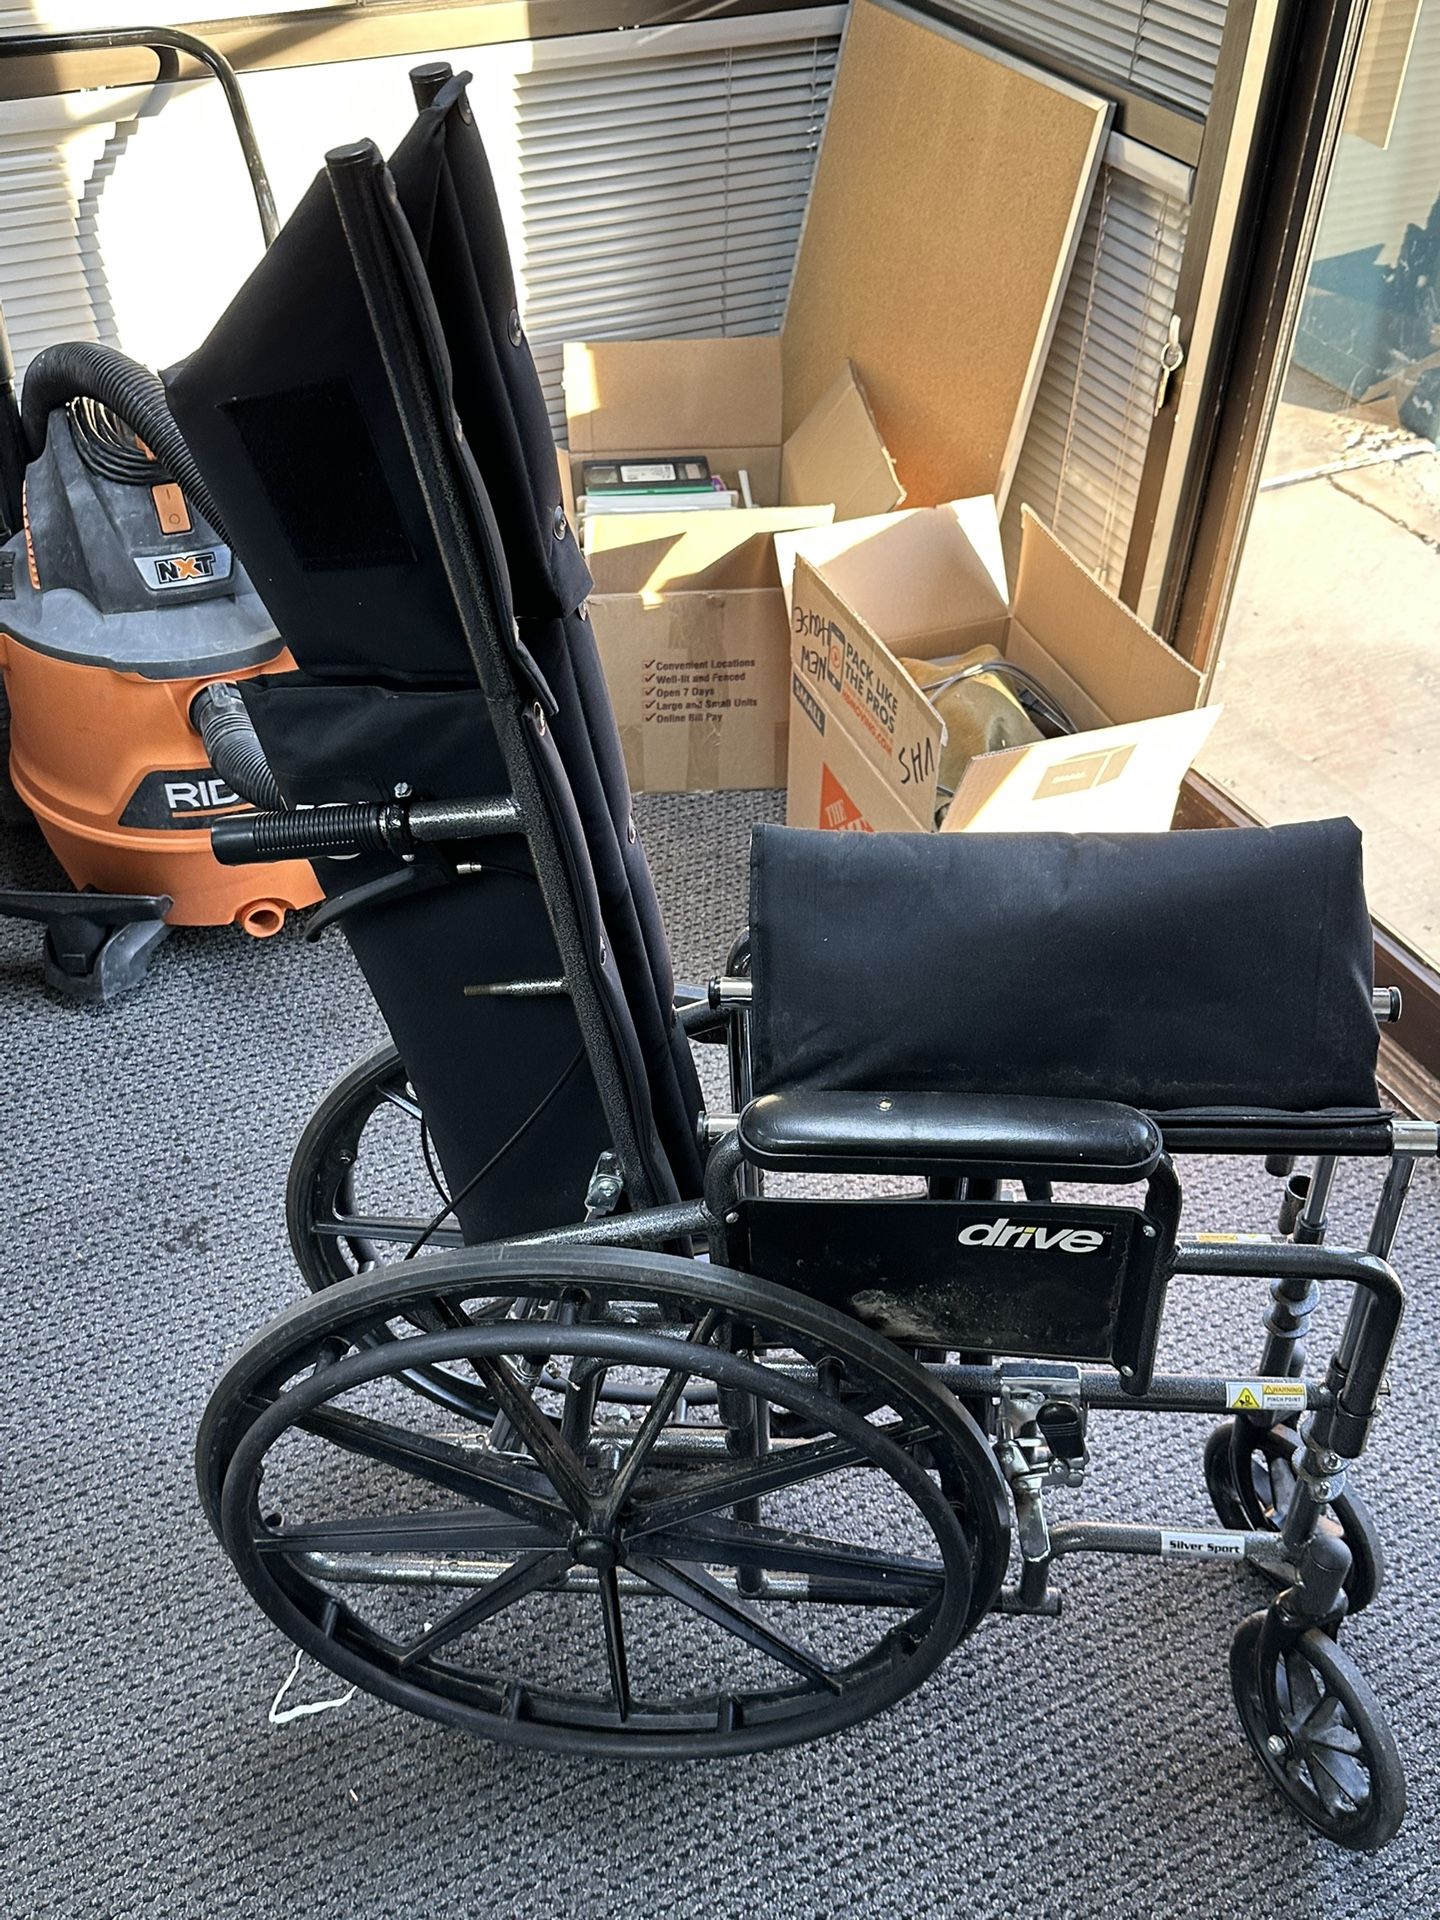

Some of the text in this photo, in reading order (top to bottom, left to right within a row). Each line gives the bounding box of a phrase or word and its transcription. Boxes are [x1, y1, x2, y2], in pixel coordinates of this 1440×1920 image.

[155, 553, 215, 584] NXT
[656, 659, 755, 671] Convenient Locations
[656, 672, 746, 684] Well-lit and Fenced
[846, 642, 874, 686] PACK
[876, 678, 898, 716] LIKE
[656, 687, 715, 698] Open 7 Days
[845, 661, 864, 697] THE
[866, 687, 895, 734] PROS
[656, 698, 758, 711] Large and Small Units
[656, 712, 723, 724] Online Bill Pay
[898, 737, 935, 785] VHS
[825, 799, 847, 828] THE
[958, 1218, 1105, 1253] drive
[1169, 1540, 1240, 1554] Silver Sport
